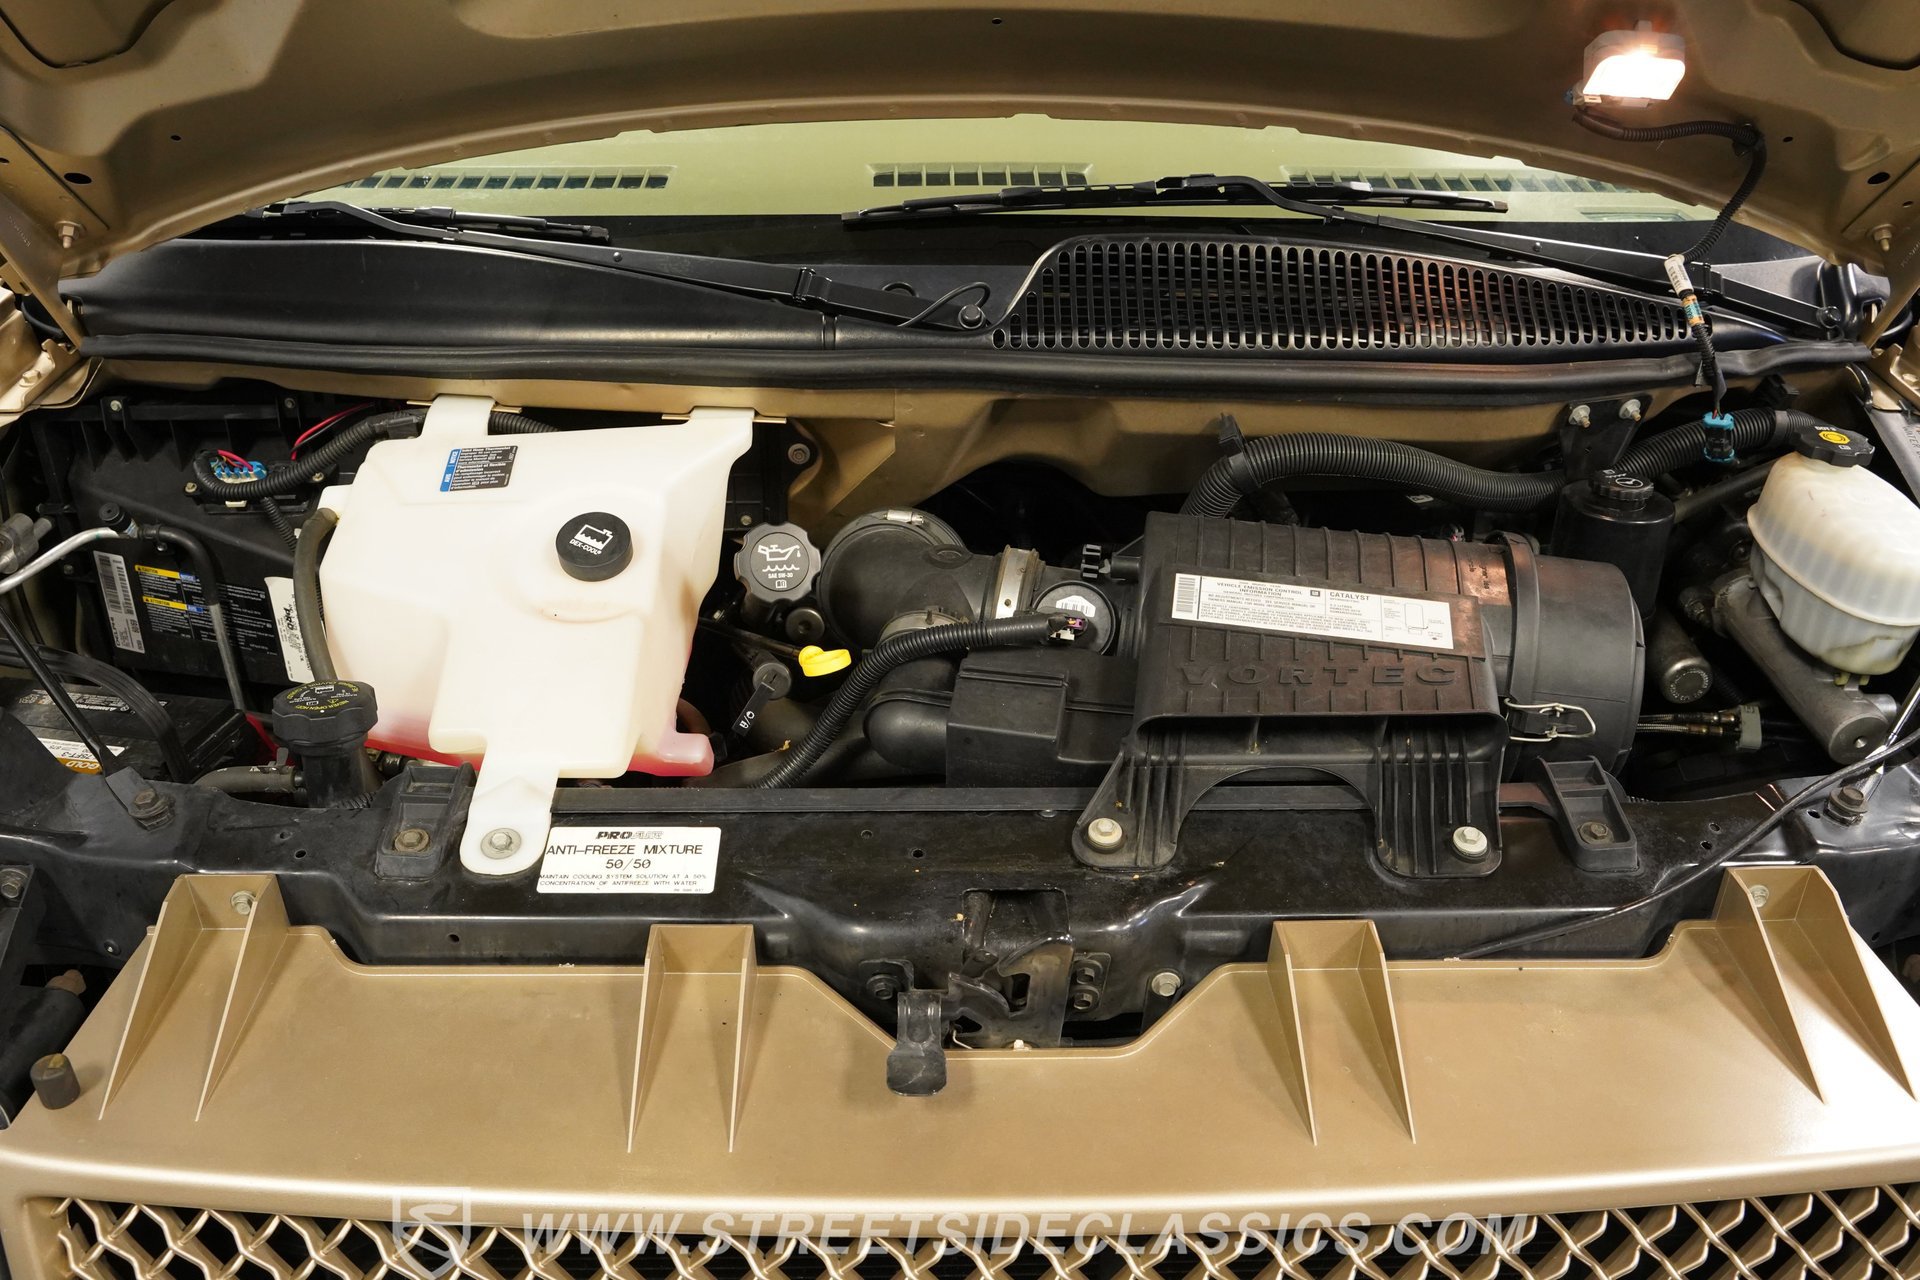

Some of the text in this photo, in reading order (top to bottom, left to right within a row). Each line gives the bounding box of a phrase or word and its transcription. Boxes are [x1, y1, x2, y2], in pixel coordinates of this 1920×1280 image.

[1329, 591, 1370, 601] CATALYST
[1179, 664, 1456, 686] VORTEC
[66, 761, 100, 769] GOLD
[545, 844, 703, 855] ANTI-FREEZE MIXTURE
[605, 858, 652, 871] 50/50
